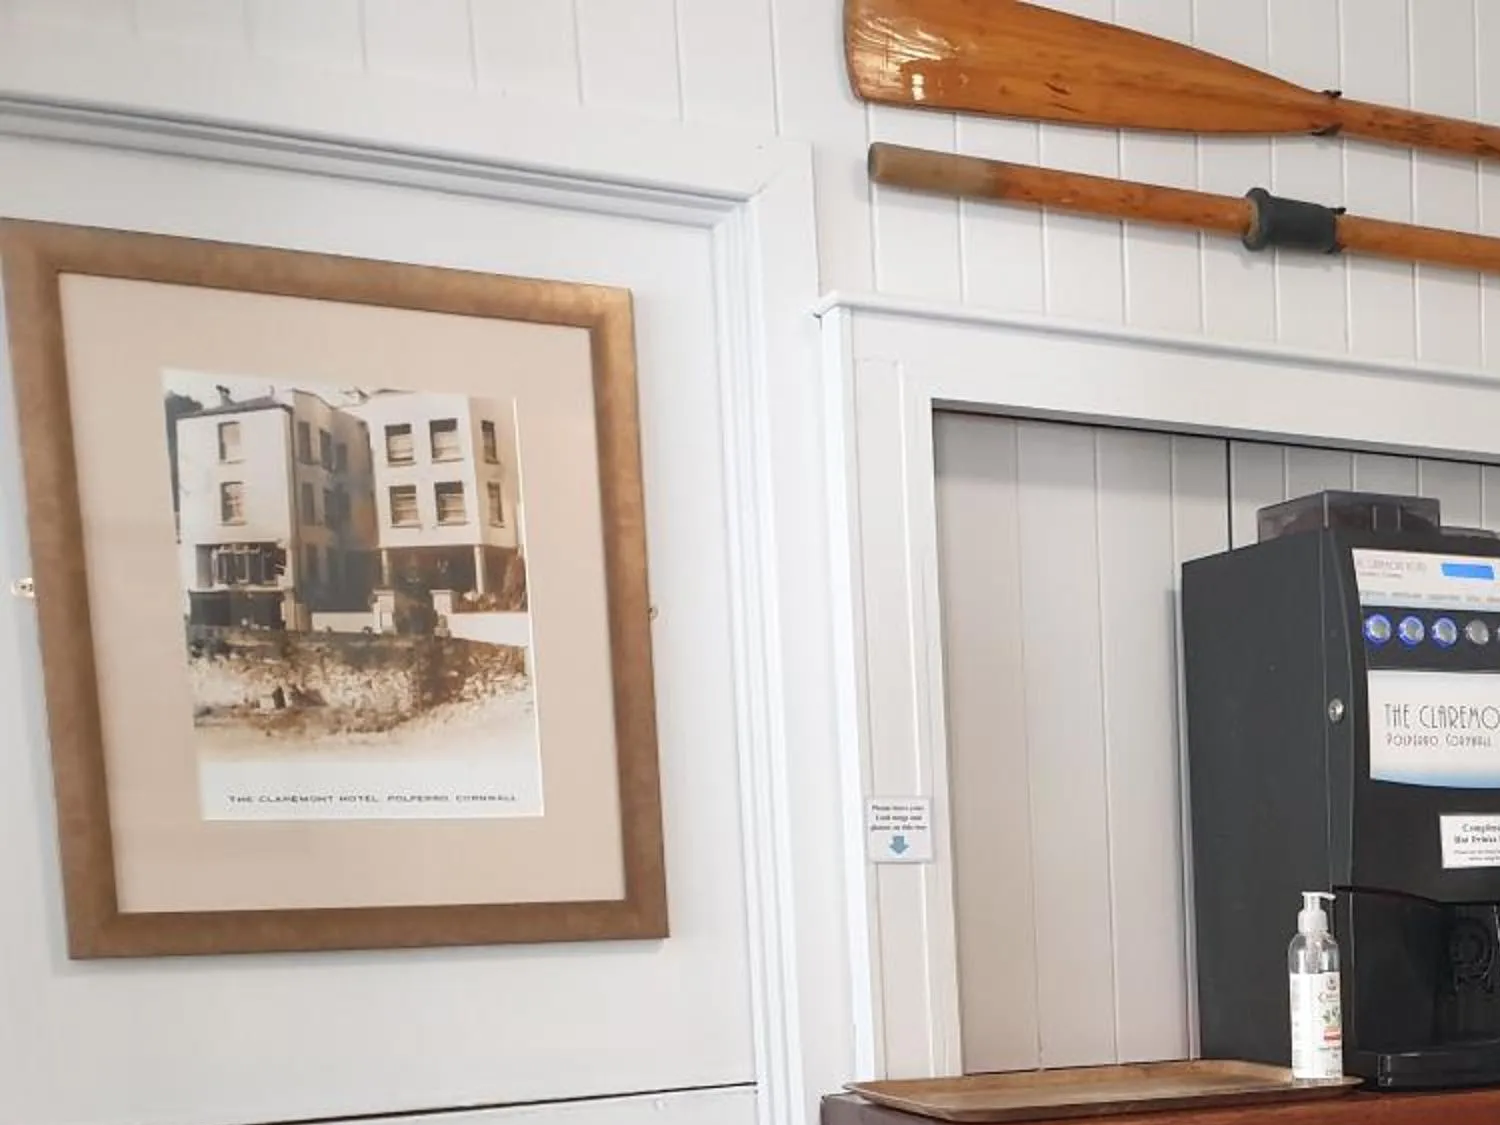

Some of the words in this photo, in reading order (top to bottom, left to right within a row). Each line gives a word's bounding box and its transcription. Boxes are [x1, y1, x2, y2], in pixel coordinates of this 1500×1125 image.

[1384, 703, 1411, 729] THE
[228, 795, 253, 803] THE
[258, 794, 334, 803] CLAREMONT
[339, 794, 379, 802] HOTEL
[387, 794, 449, 802] POLPERRO
